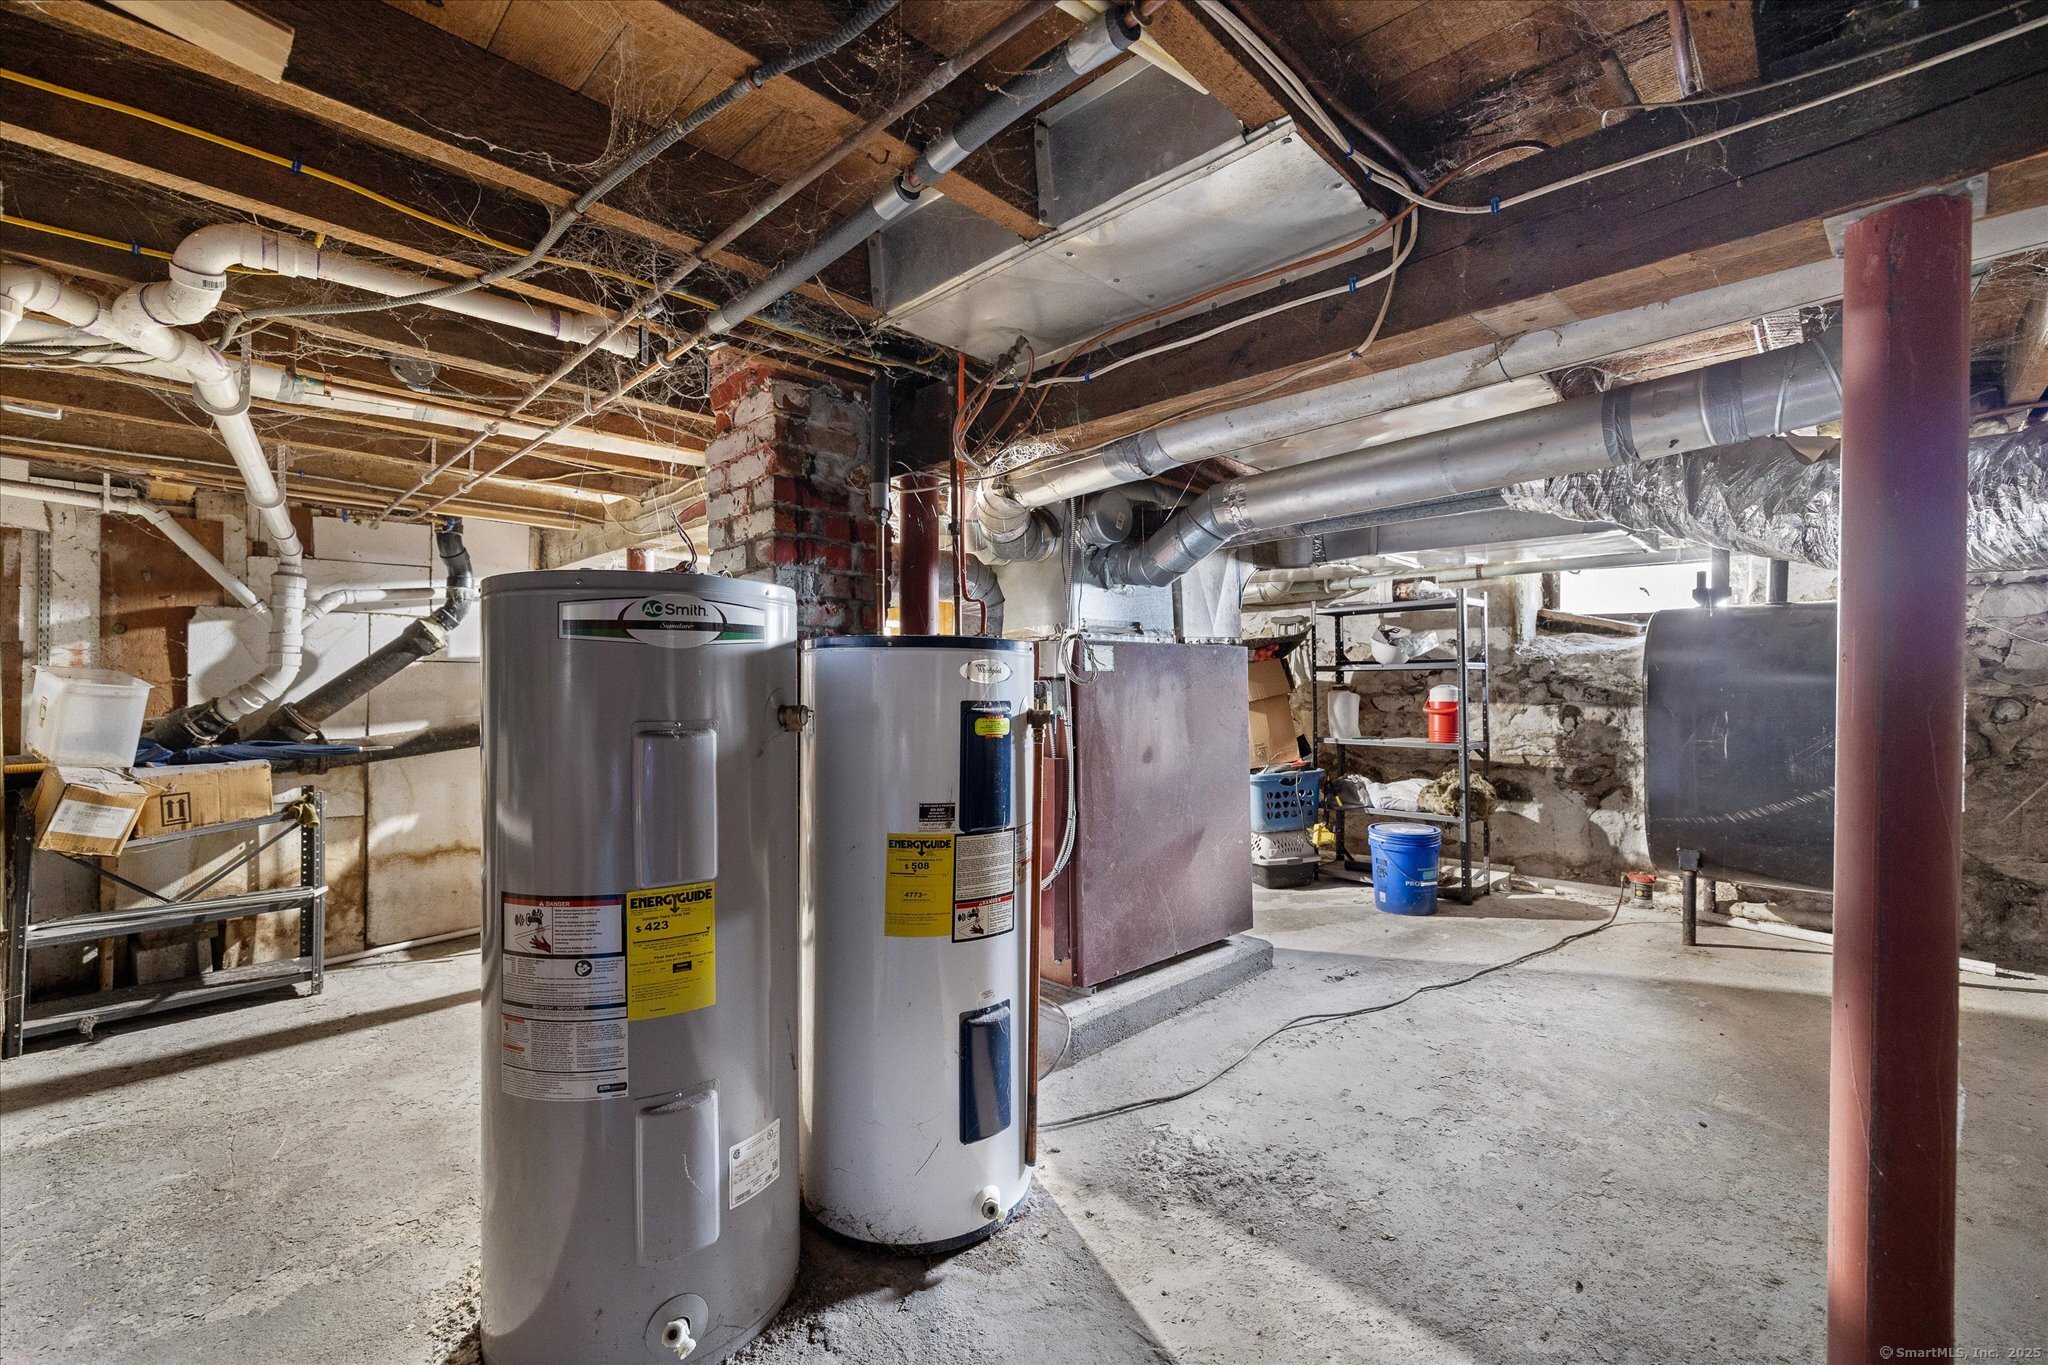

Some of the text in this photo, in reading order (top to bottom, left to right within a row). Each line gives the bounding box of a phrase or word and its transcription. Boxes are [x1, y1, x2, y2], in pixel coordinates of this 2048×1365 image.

[643, 602, 664, 616] AO
[889, 839, 952, 850] ENERGYGUIDE
[911, 862, 930, 870] 508
[630, 888, 713, 910] ENERGYGUIDE
[644, 920, 669, 932] 423
